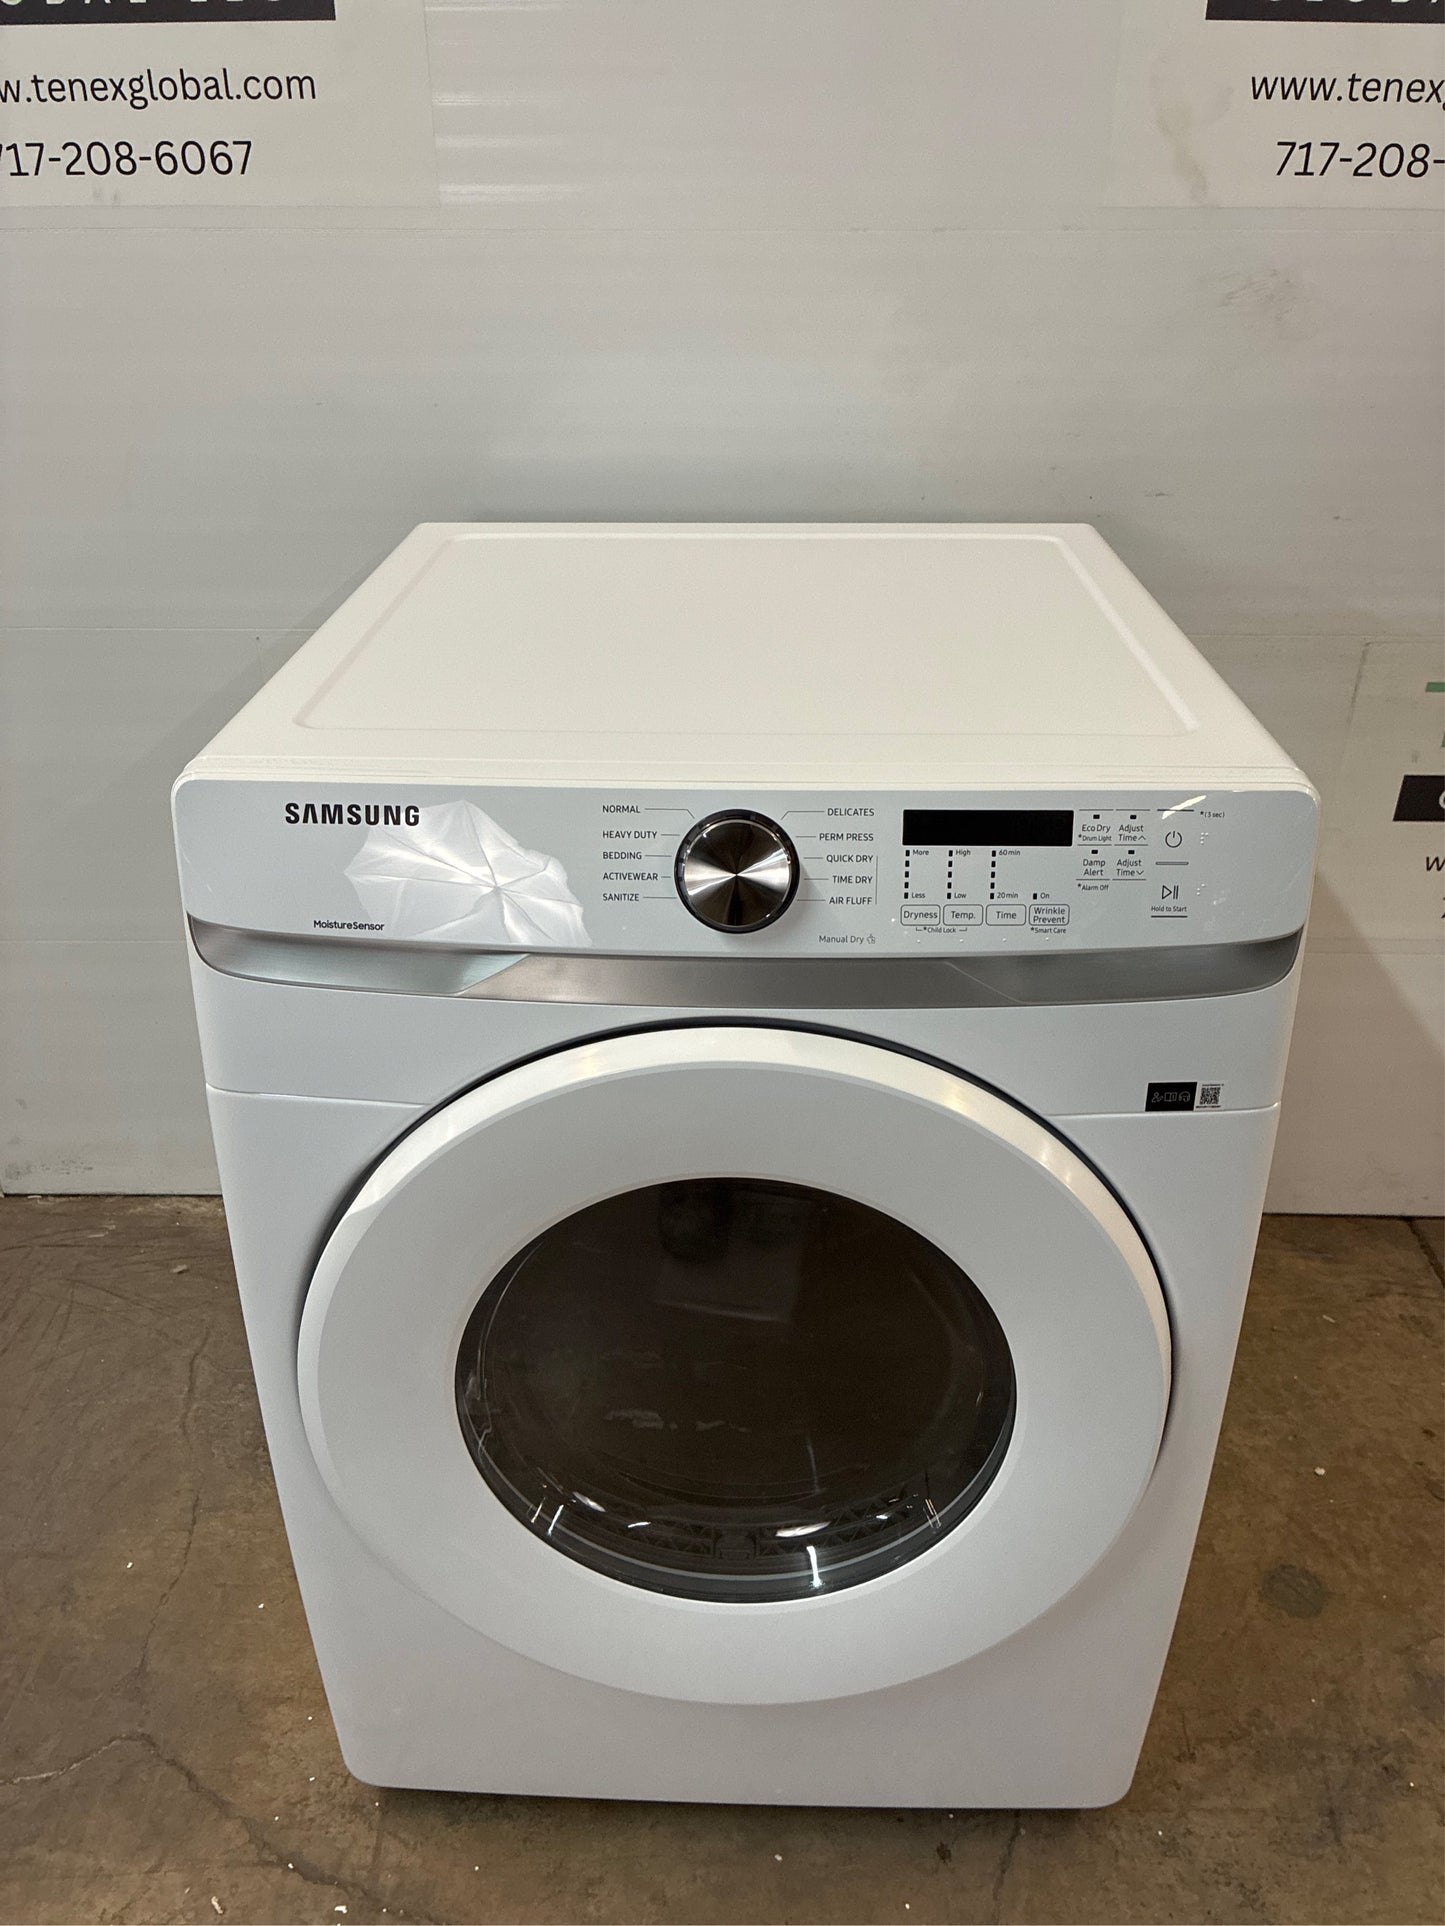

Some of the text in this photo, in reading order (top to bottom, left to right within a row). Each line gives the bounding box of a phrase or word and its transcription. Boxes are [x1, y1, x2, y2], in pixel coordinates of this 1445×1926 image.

[1251, 73, 1445, 111] www.tenex
[0, 141, 253, 177] 17-208-6067
[1276, 141, 1445, 178] 717-208-
[602, 805, 641, 814] NORMAL
[827, 808, 875, 817] DELICATES
[285, 802, 420, 827] SAMSUNG
[1081, 824, 1111, 833] Eco Dry
[1118, 824, 1144, 833] Adjust
[602, 831, 658, 839] HEAVY DUTY
[819, 833, 874, 841] PERM PRESS
[602, 852, 642, 860] BEDDING
[955, 849, 971, 857] High
[826, 854, 873, 863] QUICK DRY
[1082, 859, 1106, 867] Damp
[1116, 859, 1142, 868] Adjust
[1083, 868, 1104, 876] Alert
[602, 873, 659, 881] ACTIVEWEAR
[832, 876, 873, 884] TIME DRY
[602, 893, 640, 902] SANITIZE
[829, 896, 873, 905] AIR FLUFF
[903, 911, 938, 920] Dryness
[951, 911, 976, 920] Temp.
[996, 911, 1017, 919] Time
[1033, 907, 1066, 915] Wrinkle
[1033, 916, 1066, 924] Prevent
[819, 935, 865, 945] Manual Dry
